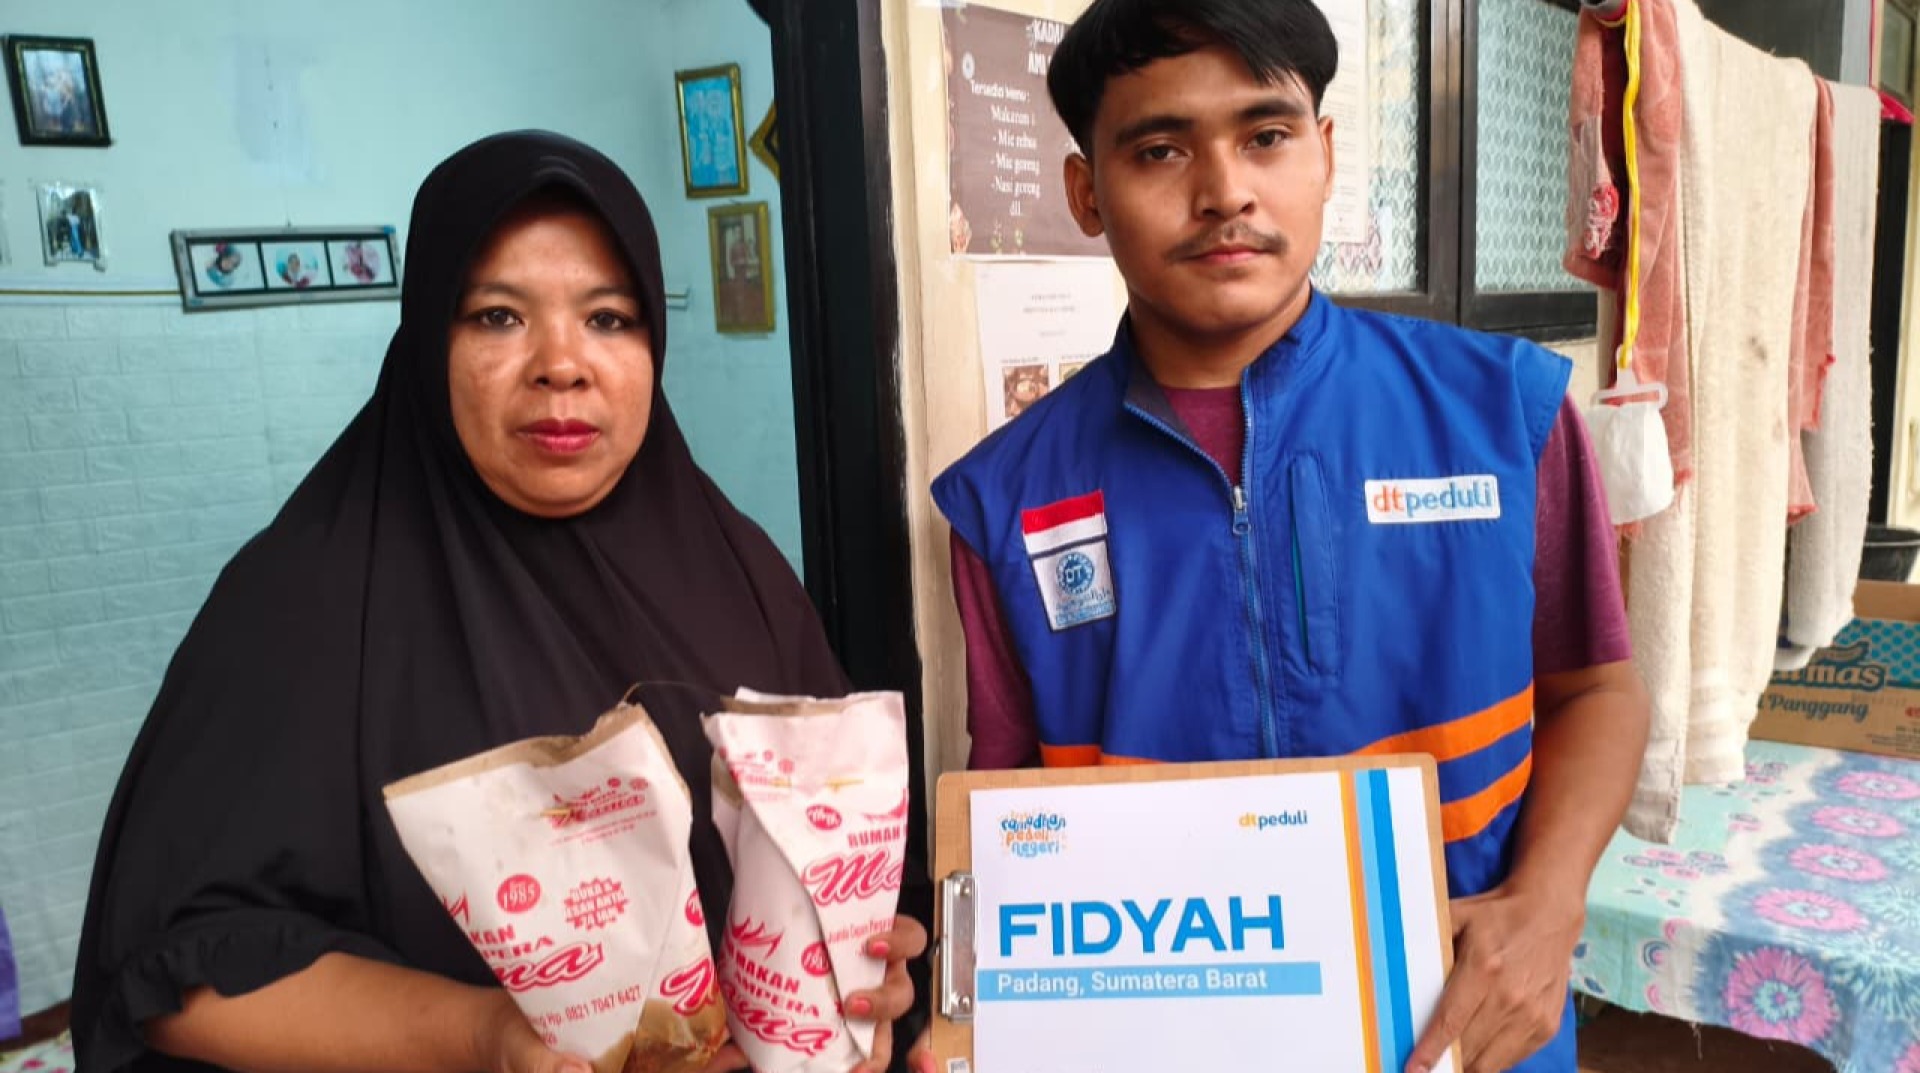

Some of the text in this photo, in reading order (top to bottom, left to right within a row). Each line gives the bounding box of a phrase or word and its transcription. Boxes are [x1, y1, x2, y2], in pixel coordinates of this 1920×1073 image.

[1373, 481, 1492, 518] dtpeduli
[1769, 693, 1869, 723] Panggang
[848, 822, 901, 848] RUMAH
[1239, 810, 1308, 830] dtpeduli
[502, 882, 536, 911] 1985
[470, 923, 516, 945] KAN
[1000, 895, 1285, 957] FIDYAH
[999, 967, 1268, 997] Padang, Sumatera Barat
[564, 1003, 590, 1022] 0821
[591, 993, 615, 1014] 7047
[617, 985, 641, 1006] 6427
